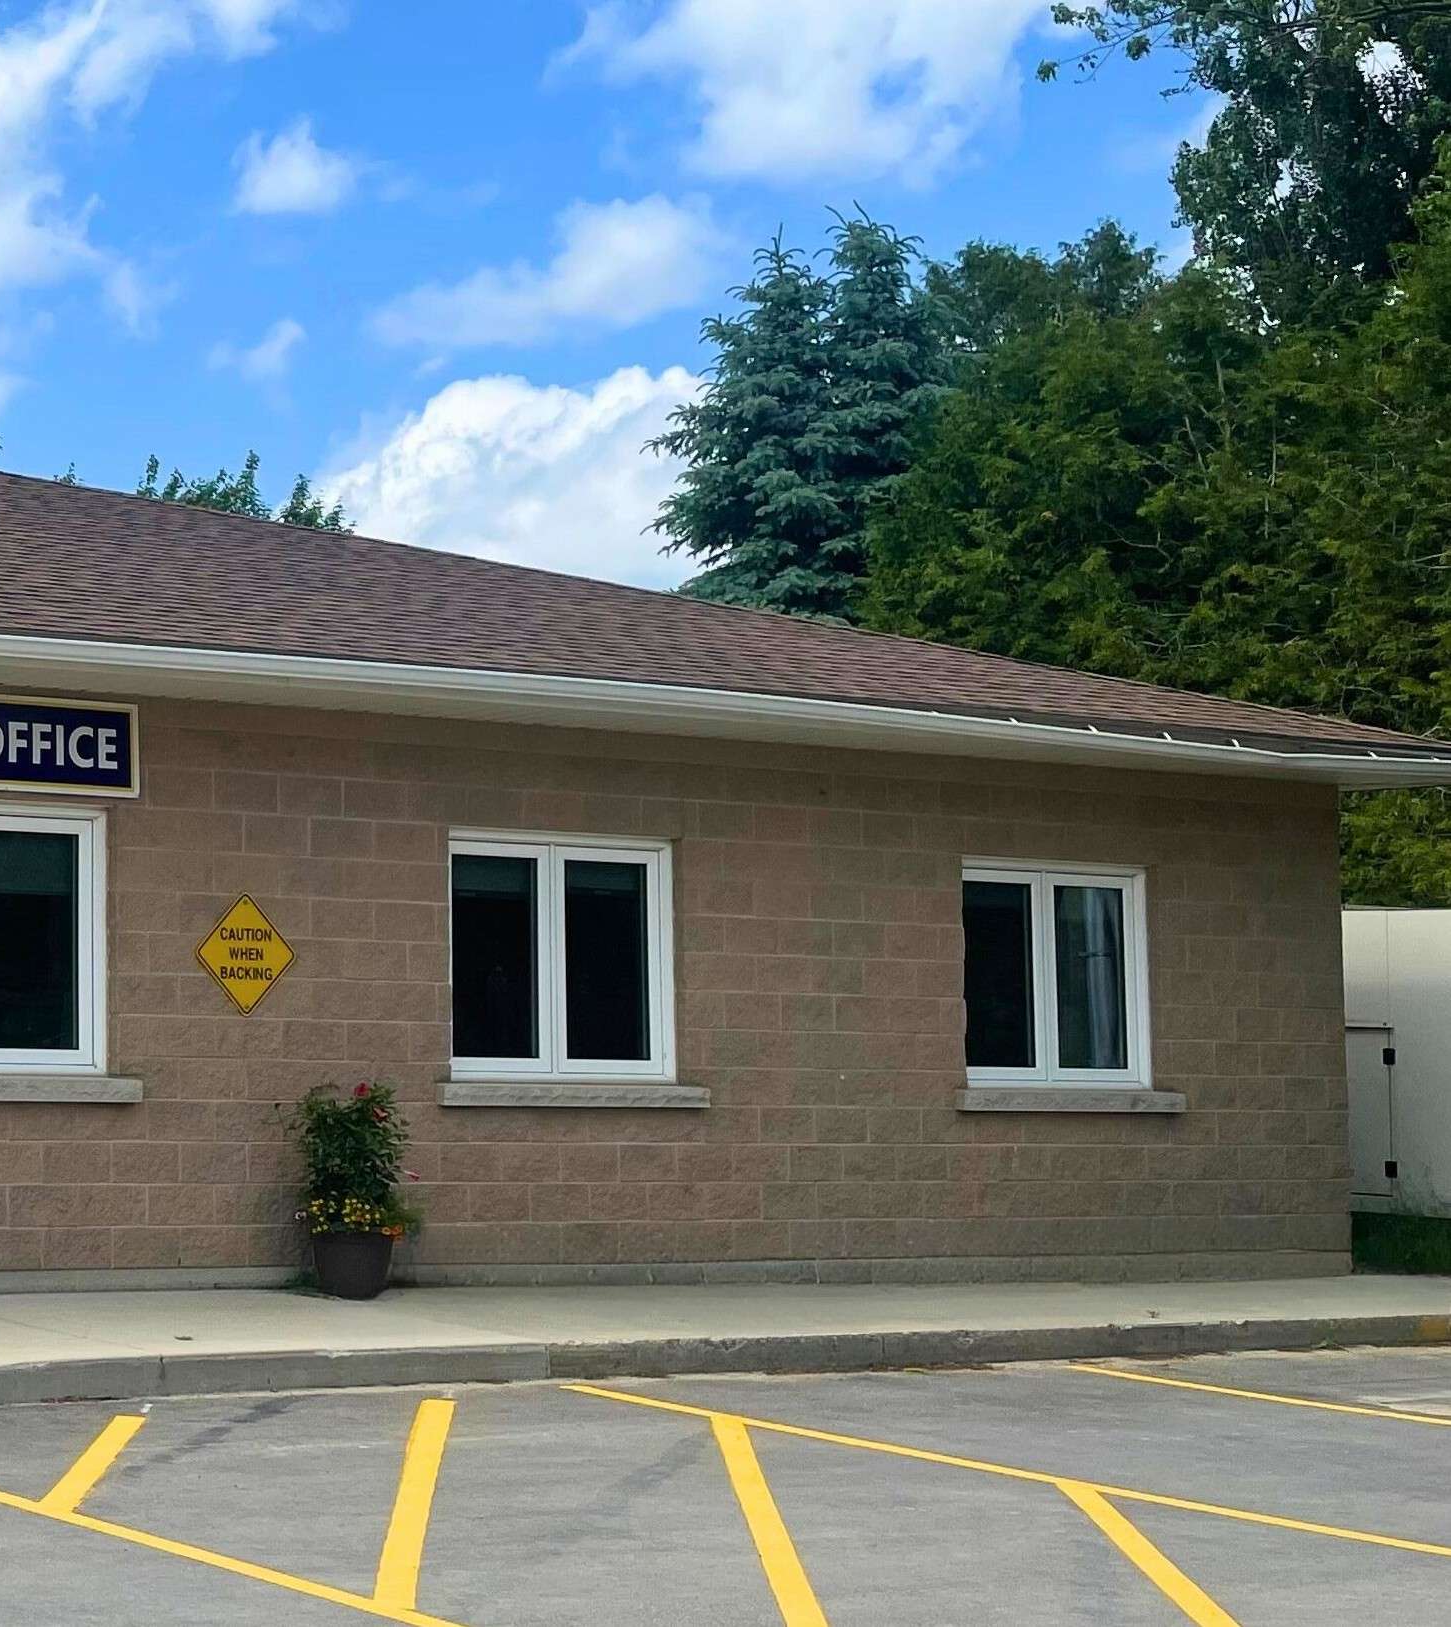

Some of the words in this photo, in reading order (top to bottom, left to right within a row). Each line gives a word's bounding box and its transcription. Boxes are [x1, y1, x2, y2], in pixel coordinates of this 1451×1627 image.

[219, 927, 272, 942] CAUTION
[229, 947, 264, 961] WHEN
[219, 966, 273, 981] BACKING
